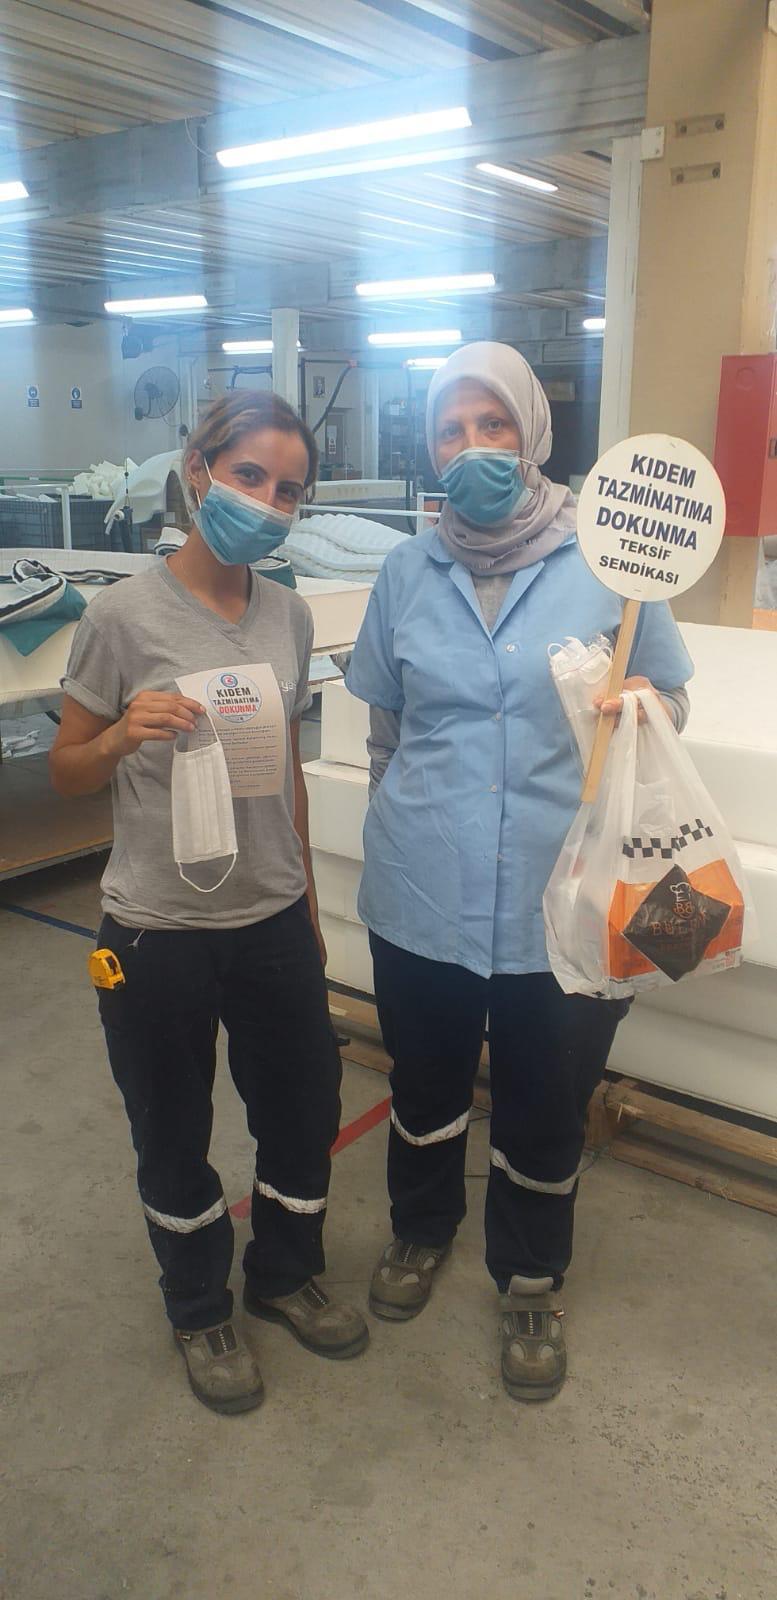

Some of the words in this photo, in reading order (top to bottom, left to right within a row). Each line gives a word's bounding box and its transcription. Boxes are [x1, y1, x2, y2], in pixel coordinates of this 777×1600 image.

[630, 453, 697, 489] KIDEM
[597, 475, 713, 525] TAZMİNATIMA
[596, 506, 697, 550] DOKUNMA
[619, 538, 672, 561] TEKSİF
[599, 555, 679, 585] SENDİKASI
[213, 696, 260, 705] TAZMİNATIMA
[216, 687, 251, 698] KIDEM
[219, 704, 258, 713] DOKUNMA
